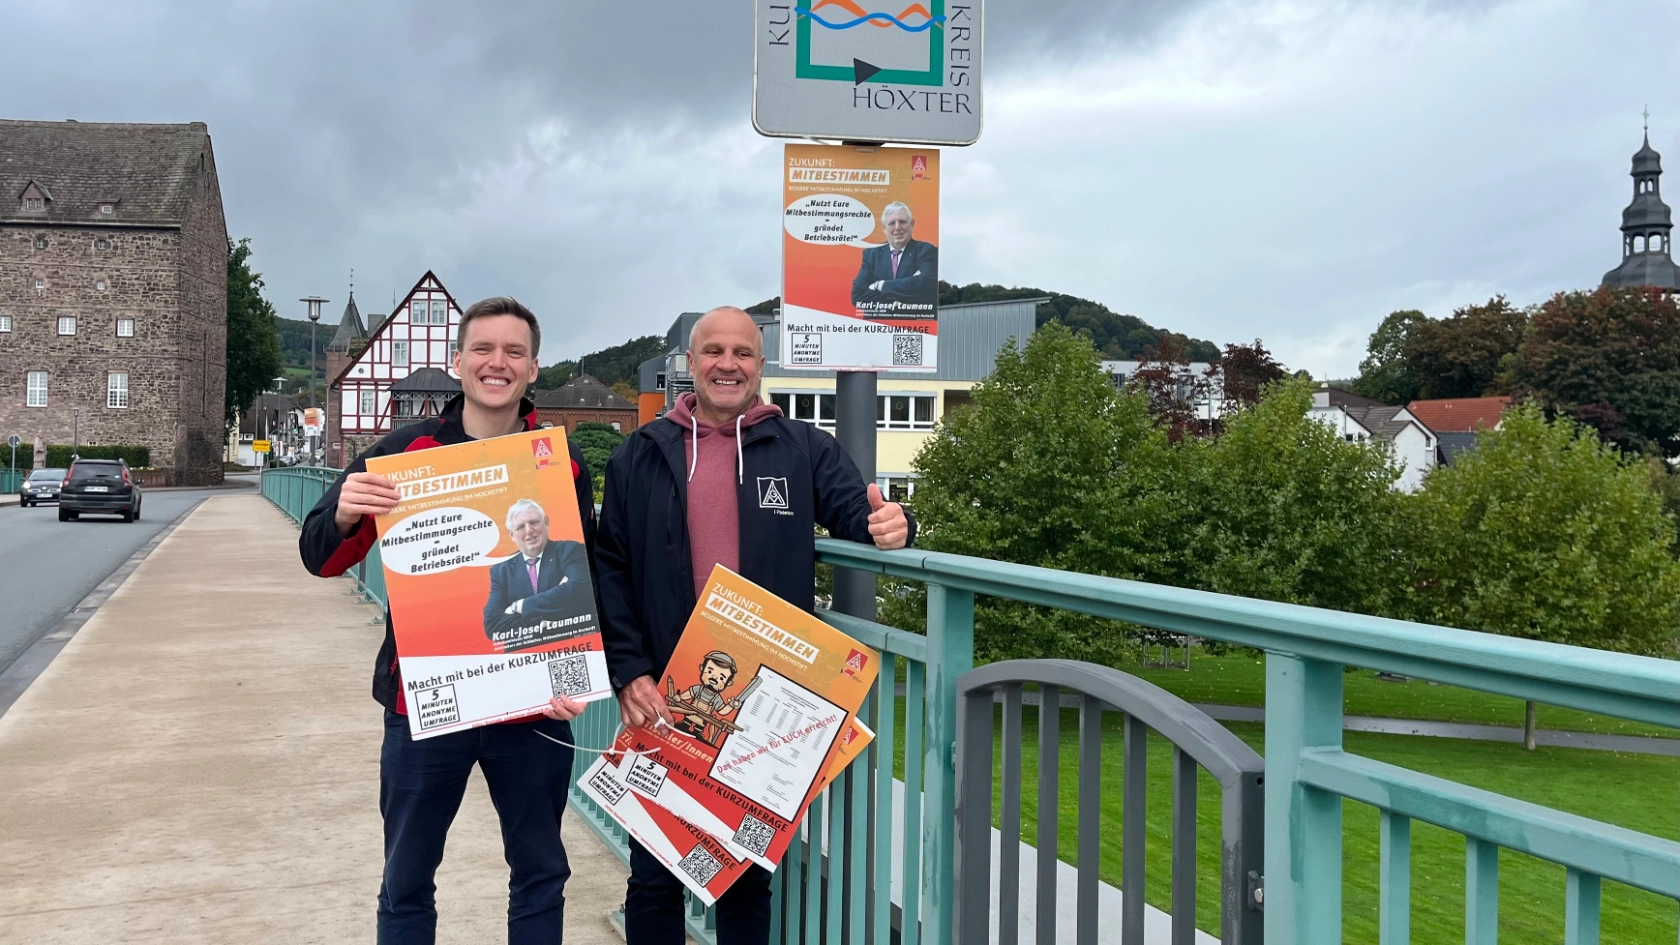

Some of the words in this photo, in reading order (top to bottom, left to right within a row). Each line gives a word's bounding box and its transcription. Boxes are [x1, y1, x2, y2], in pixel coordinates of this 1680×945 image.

[949, 5, 971, 87] KREIS
[852, 84, 972, 114] HÖXTER
[788, 158, 836, 168] ZUKUNFT:
[791, 169, 887, 182] MITBESTIMMEN
[833, 200, 850, 208] Eure
[785, 209, 872, 219] Mitbestimmungsrechte
[813, 224, 844, 233] gründet
[856, 301, 897, 311] Karl-Josef
[897, 302, 934, 310] Laumann
[787, 323, 814, 332] Macht
[816, 324, 830, 333] mit
[832, 324, 846, 333] bei
[848, 325, 862, 333] der
[864, 325, 930, 334] KURZUMFRAGE
[803, 335, 810, 343] 5
[381, 465, 436, 482] KUNFT:
[396, 467, 503, 498] ITBESTIMMEN
[408, 494, 462, 511] MITBESTIMMUNG
[474, 487, 508, 498] HOCHSTIFT
[441, 513, 463, 524] Eure
[381, 519, 493, 548] Mitbestimmungsrechte
[421, 544, 459, 561] gründet
[712, 582, 764, 616] ZUKUNFT:
[492, 621, 545, 642] Karl-Josef
[547, 613, 592, 630] Laumann
[709, 597, 814, 660] MITBESTIMMEN
[700, 610, 723, 627] BESSERE
[723, 622, 770, 651] MITBESTIMMUNG
[769, 647, 779, 656] IM
[777, 651, 808, 671] HOCHSTIFT
[408, 675, 443, 692] Macht
[446, 671, 465, 683] mit
[466, 664, 484, 678] bei
[487, 661, 505, 673] der
[508, 641, 593, 669] KURZUMFRAGE
[431, 689, 440, 700] 5
[421, 698, 454, 710] MINUTEN
[421, 706, 456, 719] ANONYME
[423, 715, 457, 727] UMFRAGE
[717, 762, 732, 774] Das
[732, 751, 757, 766] haben
[769, 739, 781, 750] für
[781, 728, 805, 744] EUCH
[804, 713, 838, 734] erreicht!
[635, 764, 662, 781] MINUTEN
[646, 762, 657, 770] 5
[596, 775, 621, 798] ANONYME
[601, 770, 625, 792] MINUTEN
[629, 777, 657, 794] UMFRAGE
[630, 770, 659, 788] ANONYME
[592, 780, 617, 802] UMFRAGE
[665, 759, 682, 772] mit
[682, 767, 698, 781] bei
[698, 777, 715, 791] der
[716, 786, 789, 833] KURZUMFRAGE
